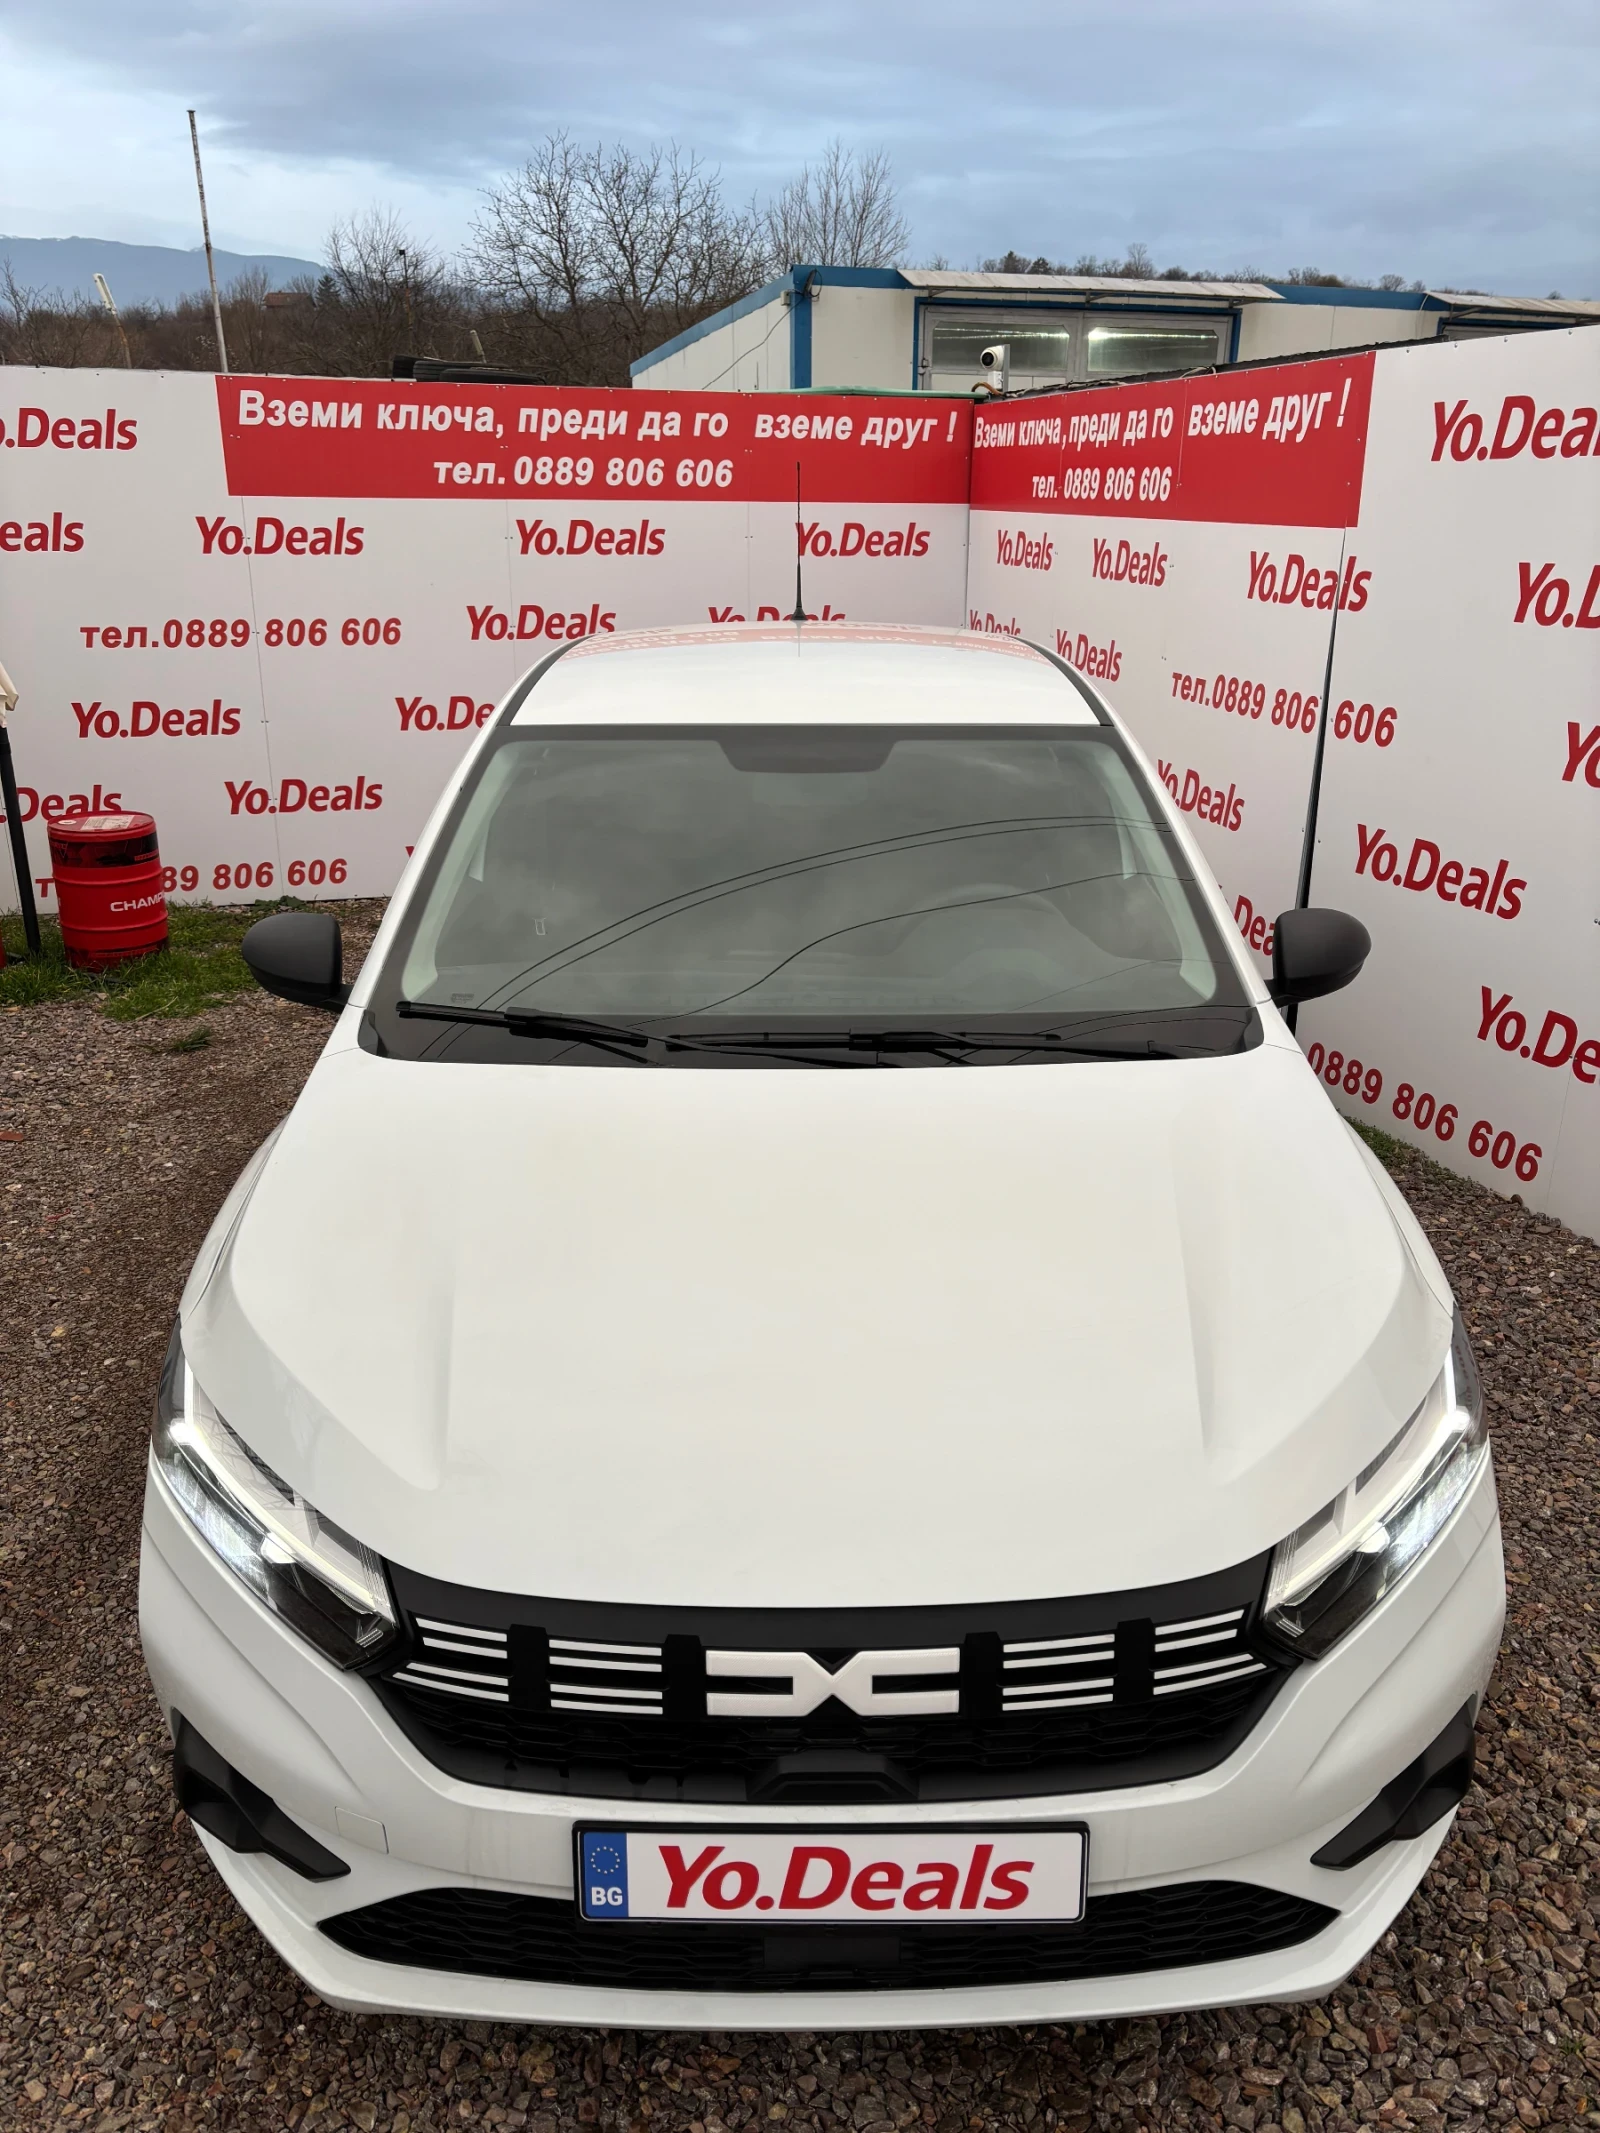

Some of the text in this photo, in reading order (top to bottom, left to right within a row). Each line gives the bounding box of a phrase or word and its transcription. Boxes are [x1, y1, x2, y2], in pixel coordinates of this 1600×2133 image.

[0, 408, 137, 450] .Deals
[239, 390, 956, 449] Вземи ключа, преди да го вземе друг !
[975, 378, 1351, 451] Вземи ключа, преди да го вземе друг !
[434, 456, 733, 487] тел. 0889 806 606
[1033, 467, 1171, 501] тел. 0889 806 606
[0, 512, 83, 552] eals
[196, 516, 364, 556] Yo.Deals
[516, 520, 665, 556] Yo.Deals
[796, 522, 930, 557] Yo.Deals
[998, 531, 1053, 570] Yo.Deals
[1093, 539, 1167, 586] Yo.Deals
[1248, 552, 1371, 612] Yo.Deals
[80, 618, 400, 648] тел.0889 806 606
[467, 604, 616, 640] Yo.Deals
[1056, 629, 1122, 682] Yo.Deals
[72, 700, 240, 738] Yo.Deals
[1173, 673, 1397, 748] тел.0889 806 606
[224, 776, 382, 815] Yo.Deals
[1158, 761, 1244, 831] Yo.Deals
[213, 862, 273, 890] 806
[288, 859, 346, 886] 606
[1356, 824, 1526, 920] Yo.Deals
[1478, 987, 1600, 1084] Yo.De
[1309, 1044, 1541, 1181] 0889 806 606
[592, 1887, 622, 1905] BG
[659, 1844, 1034, 1911] Yo.Deals
